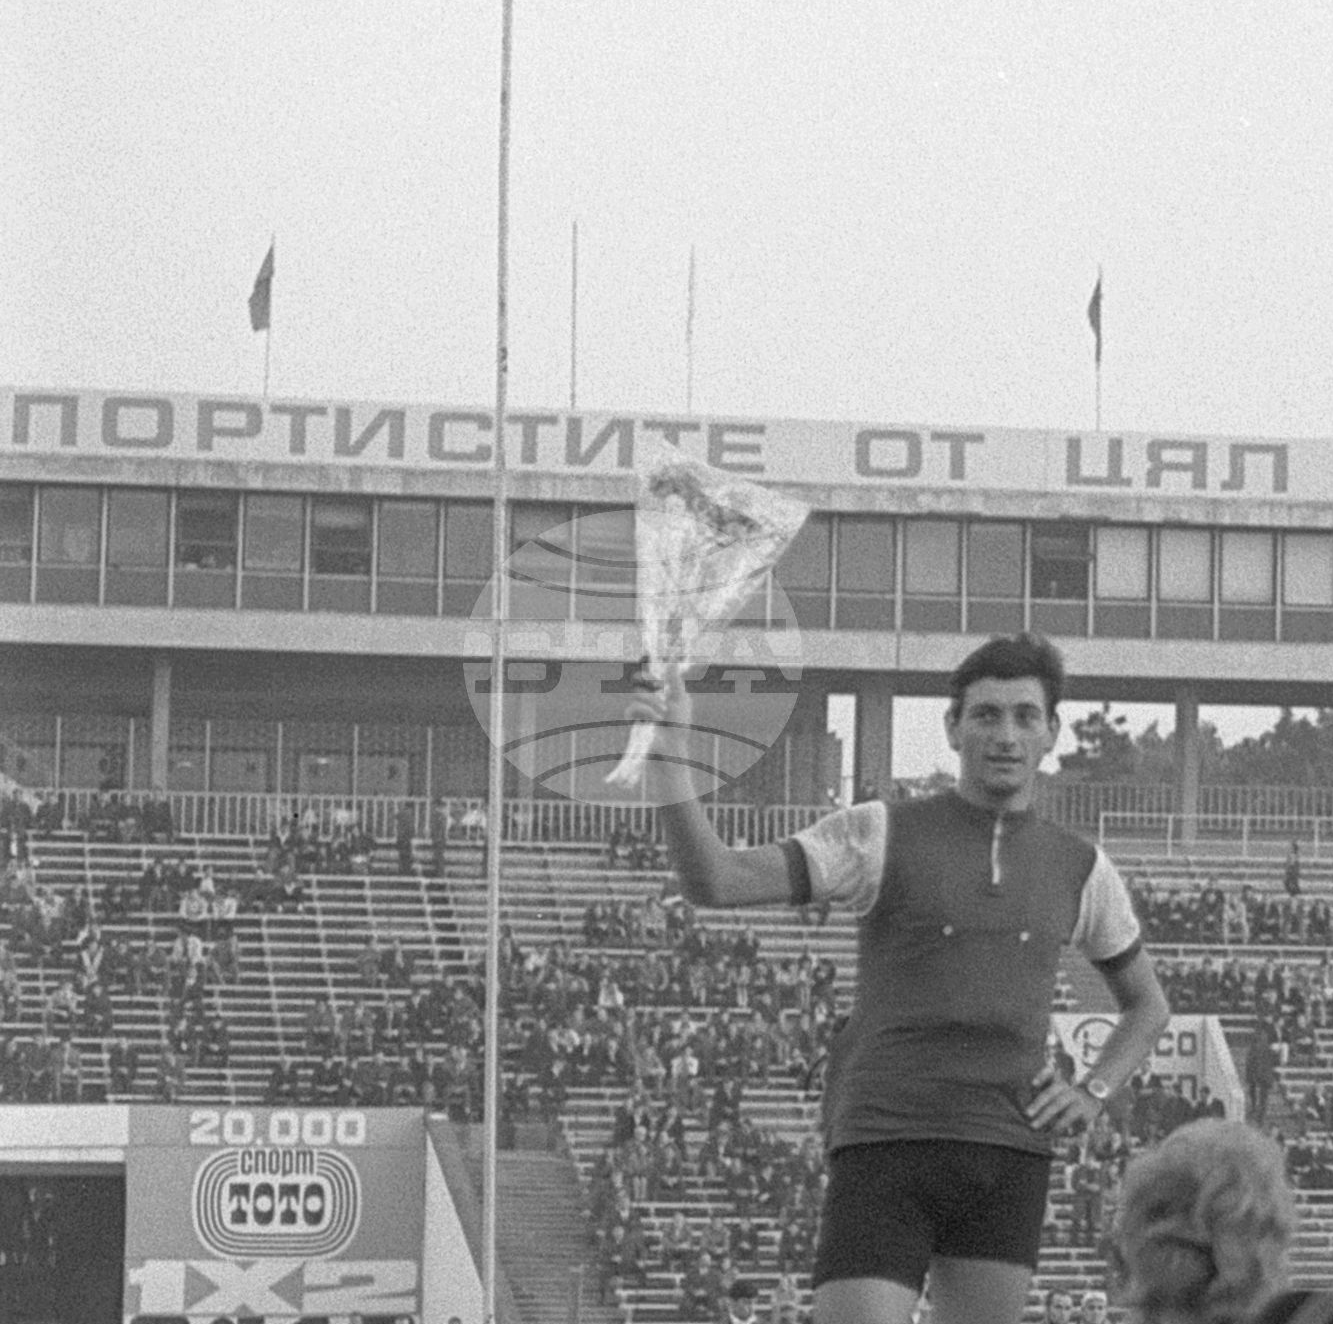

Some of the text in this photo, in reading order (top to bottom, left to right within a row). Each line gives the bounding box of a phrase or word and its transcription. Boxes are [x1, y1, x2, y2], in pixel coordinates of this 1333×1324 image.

[11, 392, 766, 474] ПОРТИСТИТЕ
[854, 429, 984, 479] ОТ
[1066, 436, 1289, 495] ЦЯЛ
[189, 1109, 366, 1146] 20.000
[228, 1182, 326, 1226] ТОТО
